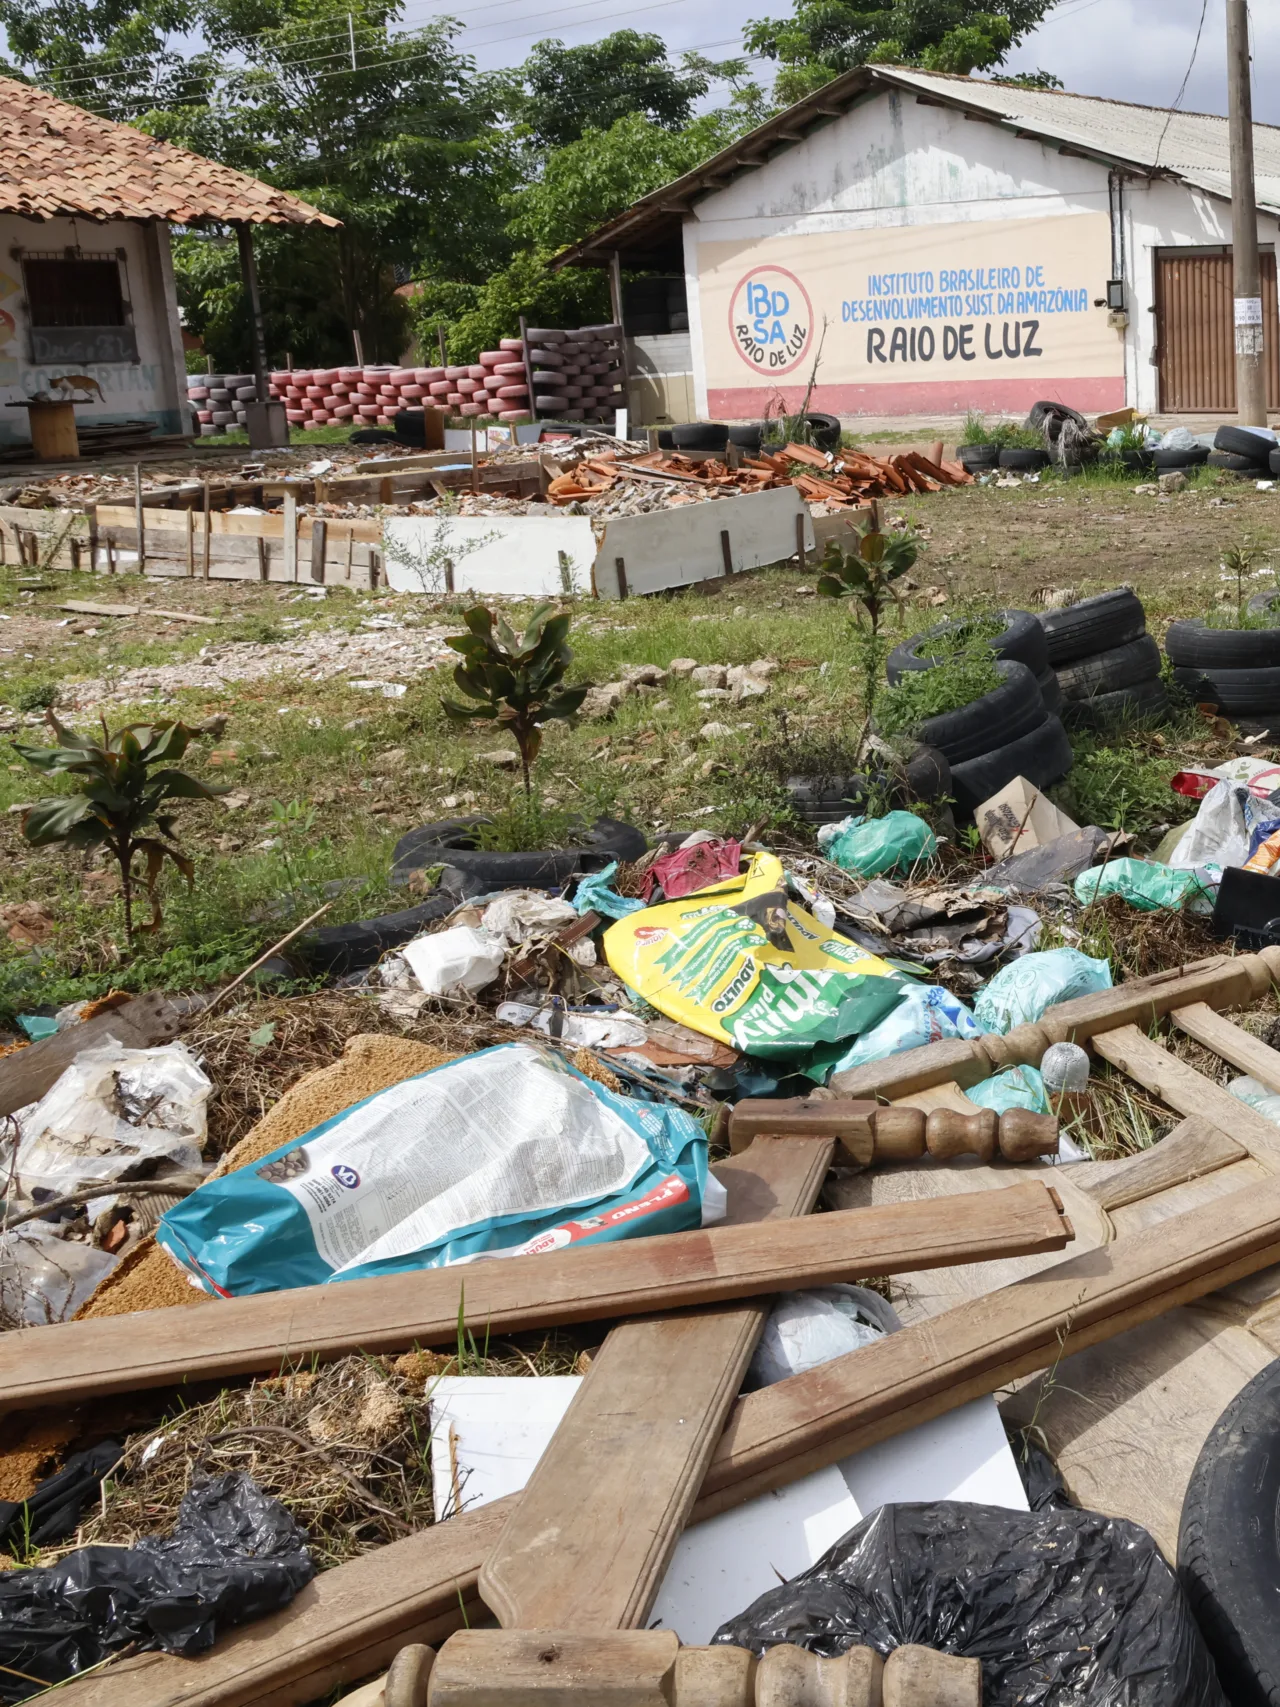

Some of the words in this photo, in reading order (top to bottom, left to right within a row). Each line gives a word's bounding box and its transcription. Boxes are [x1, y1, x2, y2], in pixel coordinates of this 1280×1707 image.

[868, 271, 934, 296] INSTITUTO
[939, 266, 1021, 292] BRASILEIRO
[1025, 266, 1045, 287] DE
[842, 295, 963, 322] DESENVOLVIMENTO
[999, 292, 1015, 315] DA
[1016, 287, 1088, 314] AMAZÔNIA
[736, 324, 764, 363] RAIO
[770, 350, 787, 367] DE
[786, 324, 807, 357] LUZ
[753, 319, 787, 344] SA
[867, 326, 935, 363] RAIO
[943, 324, 976, 361] DE
[984, 320, 1043, 359] LUZ
[713, 956, 756, 1013] ADULTO
[740, 983, 776, 1021] plus
[611, 1189, 675, 1220] PLENO
